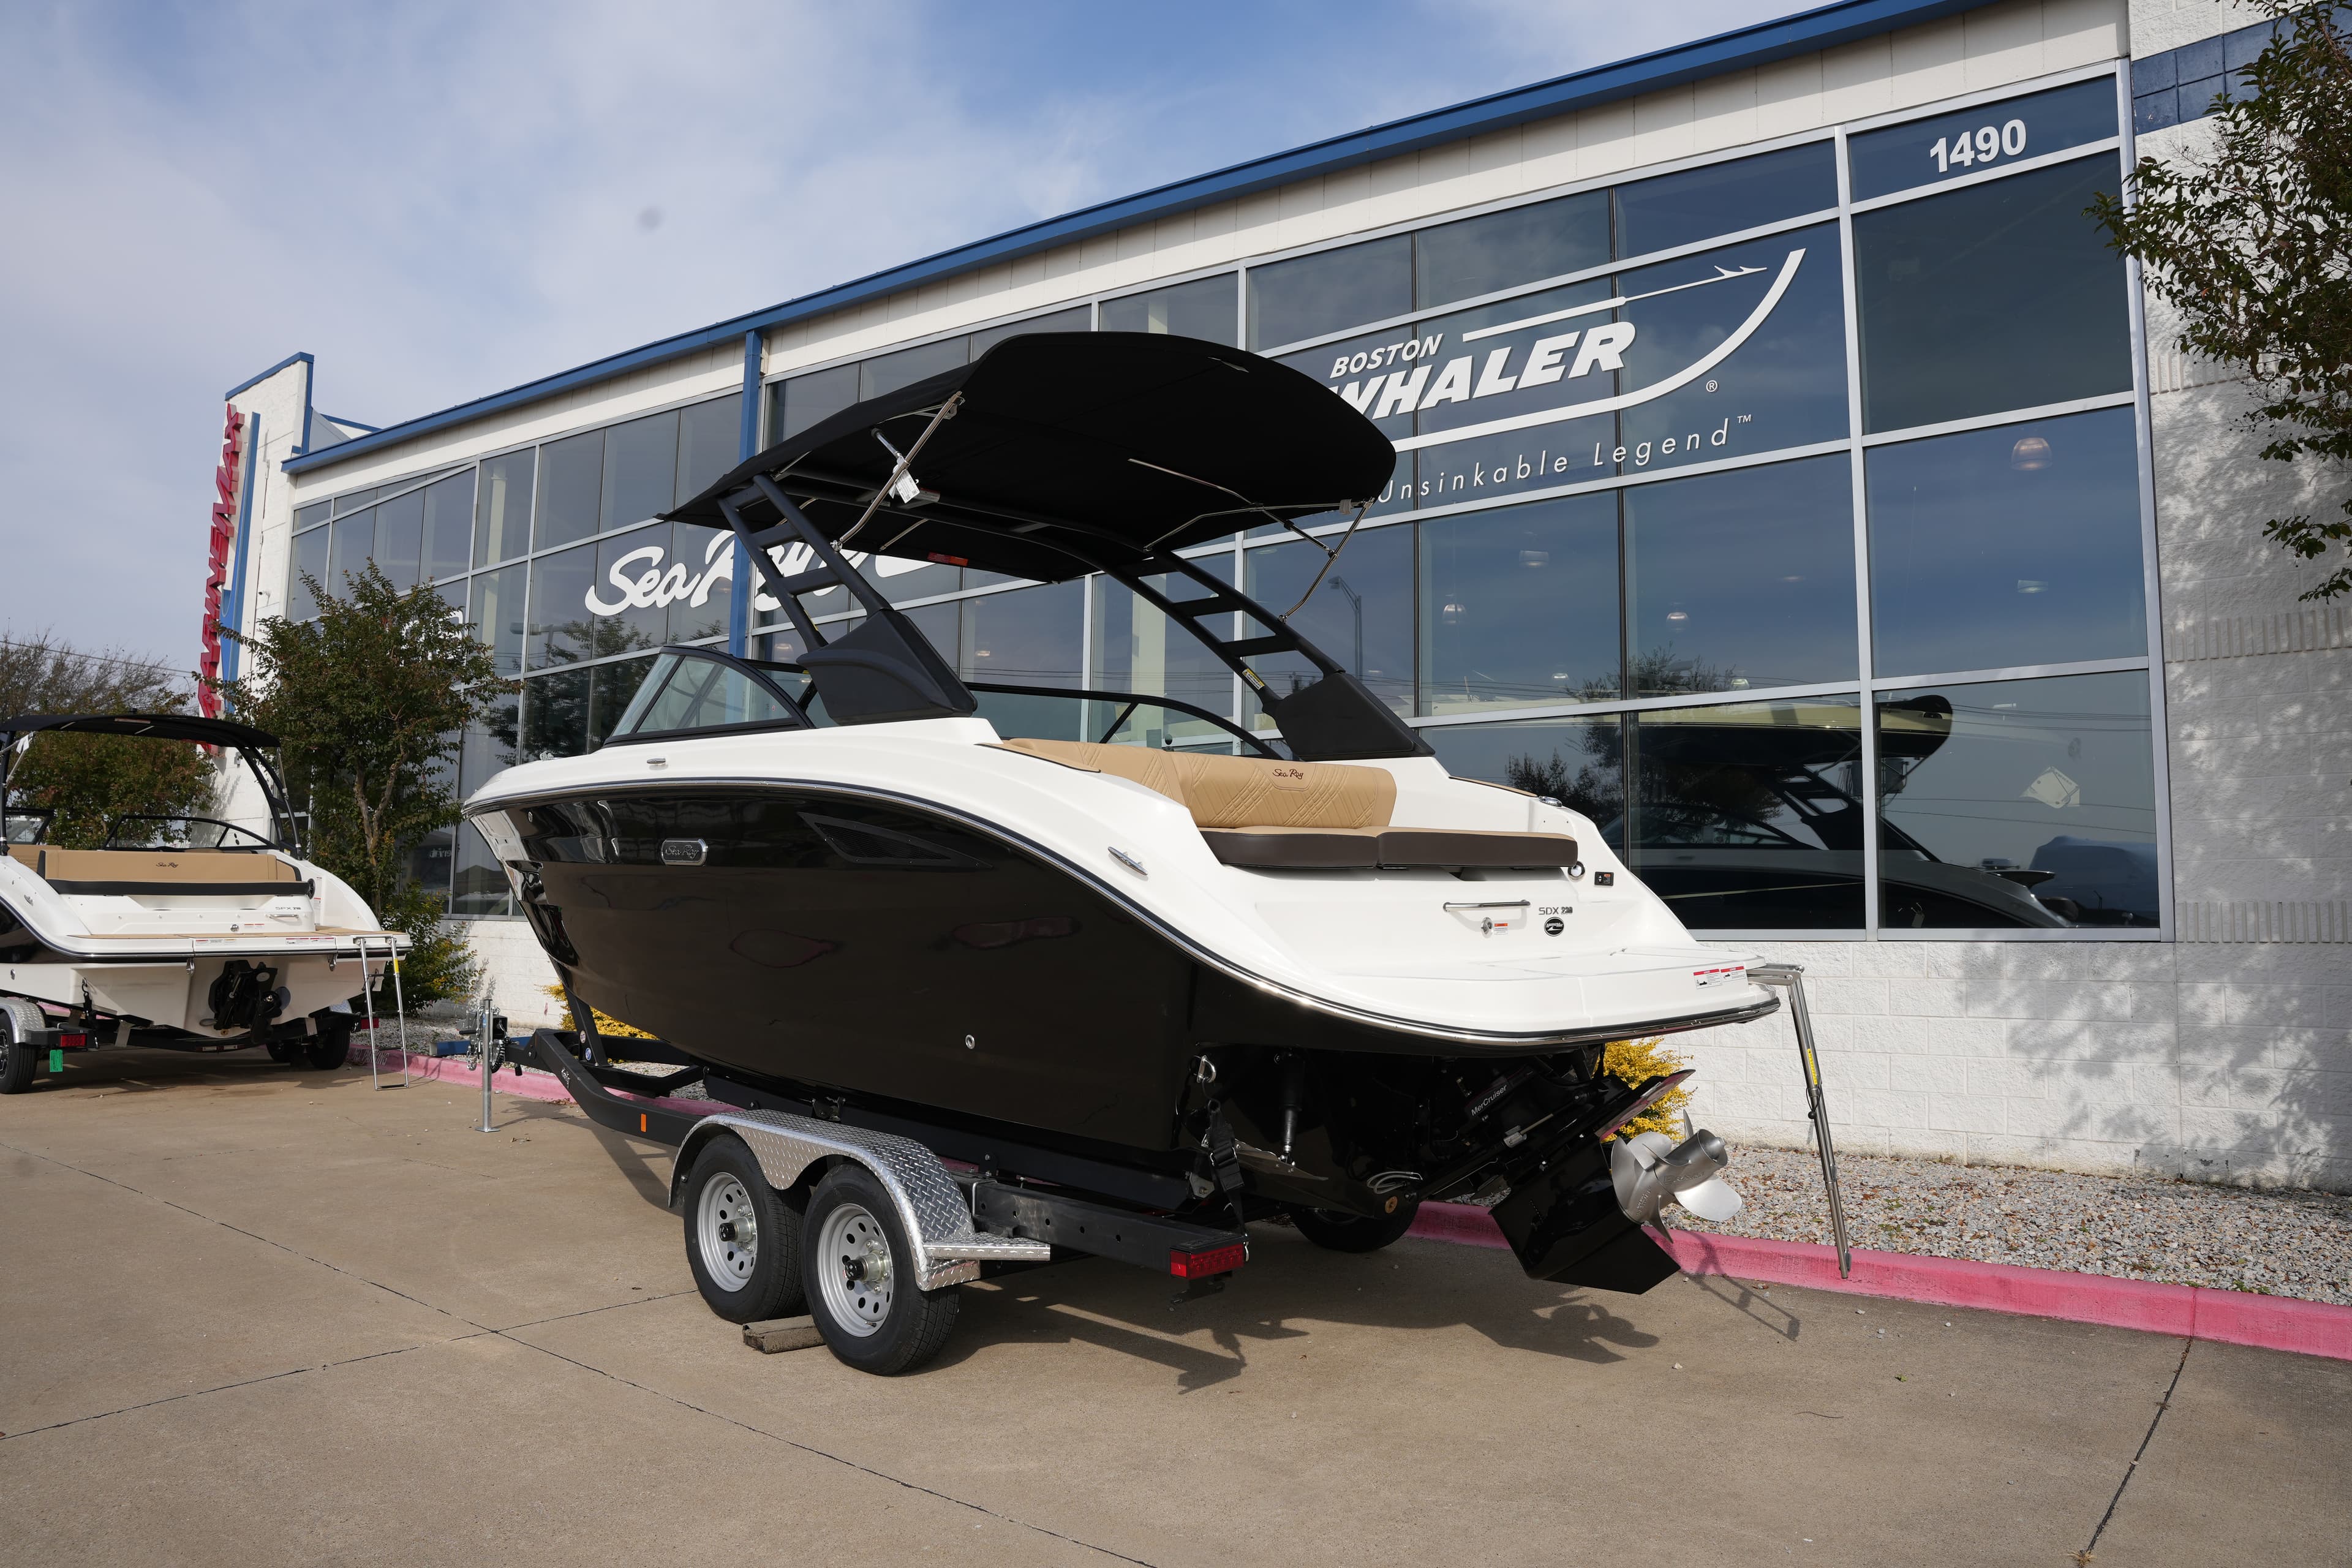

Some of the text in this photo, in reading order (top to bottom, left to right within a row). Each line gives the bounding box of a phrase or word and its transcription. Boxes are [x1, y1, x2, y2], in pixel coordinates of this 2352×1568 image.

[1930, 119, 2026, 173] 1490
[1330, 333, 1443, 379] BOSTON
[1378, 450, 1568, 503] Unsinkable
[1594, 418, 1729, 466] Legend
[584, 546, 701, 616] Sea
[1272, 768, 1304, 780] Sea Ray
[665, 845, 699, 858] Sea Ray
[1538, 907, 1559, 915] SDX
[1471, 1084, 1507, 1116] MerCruiser
